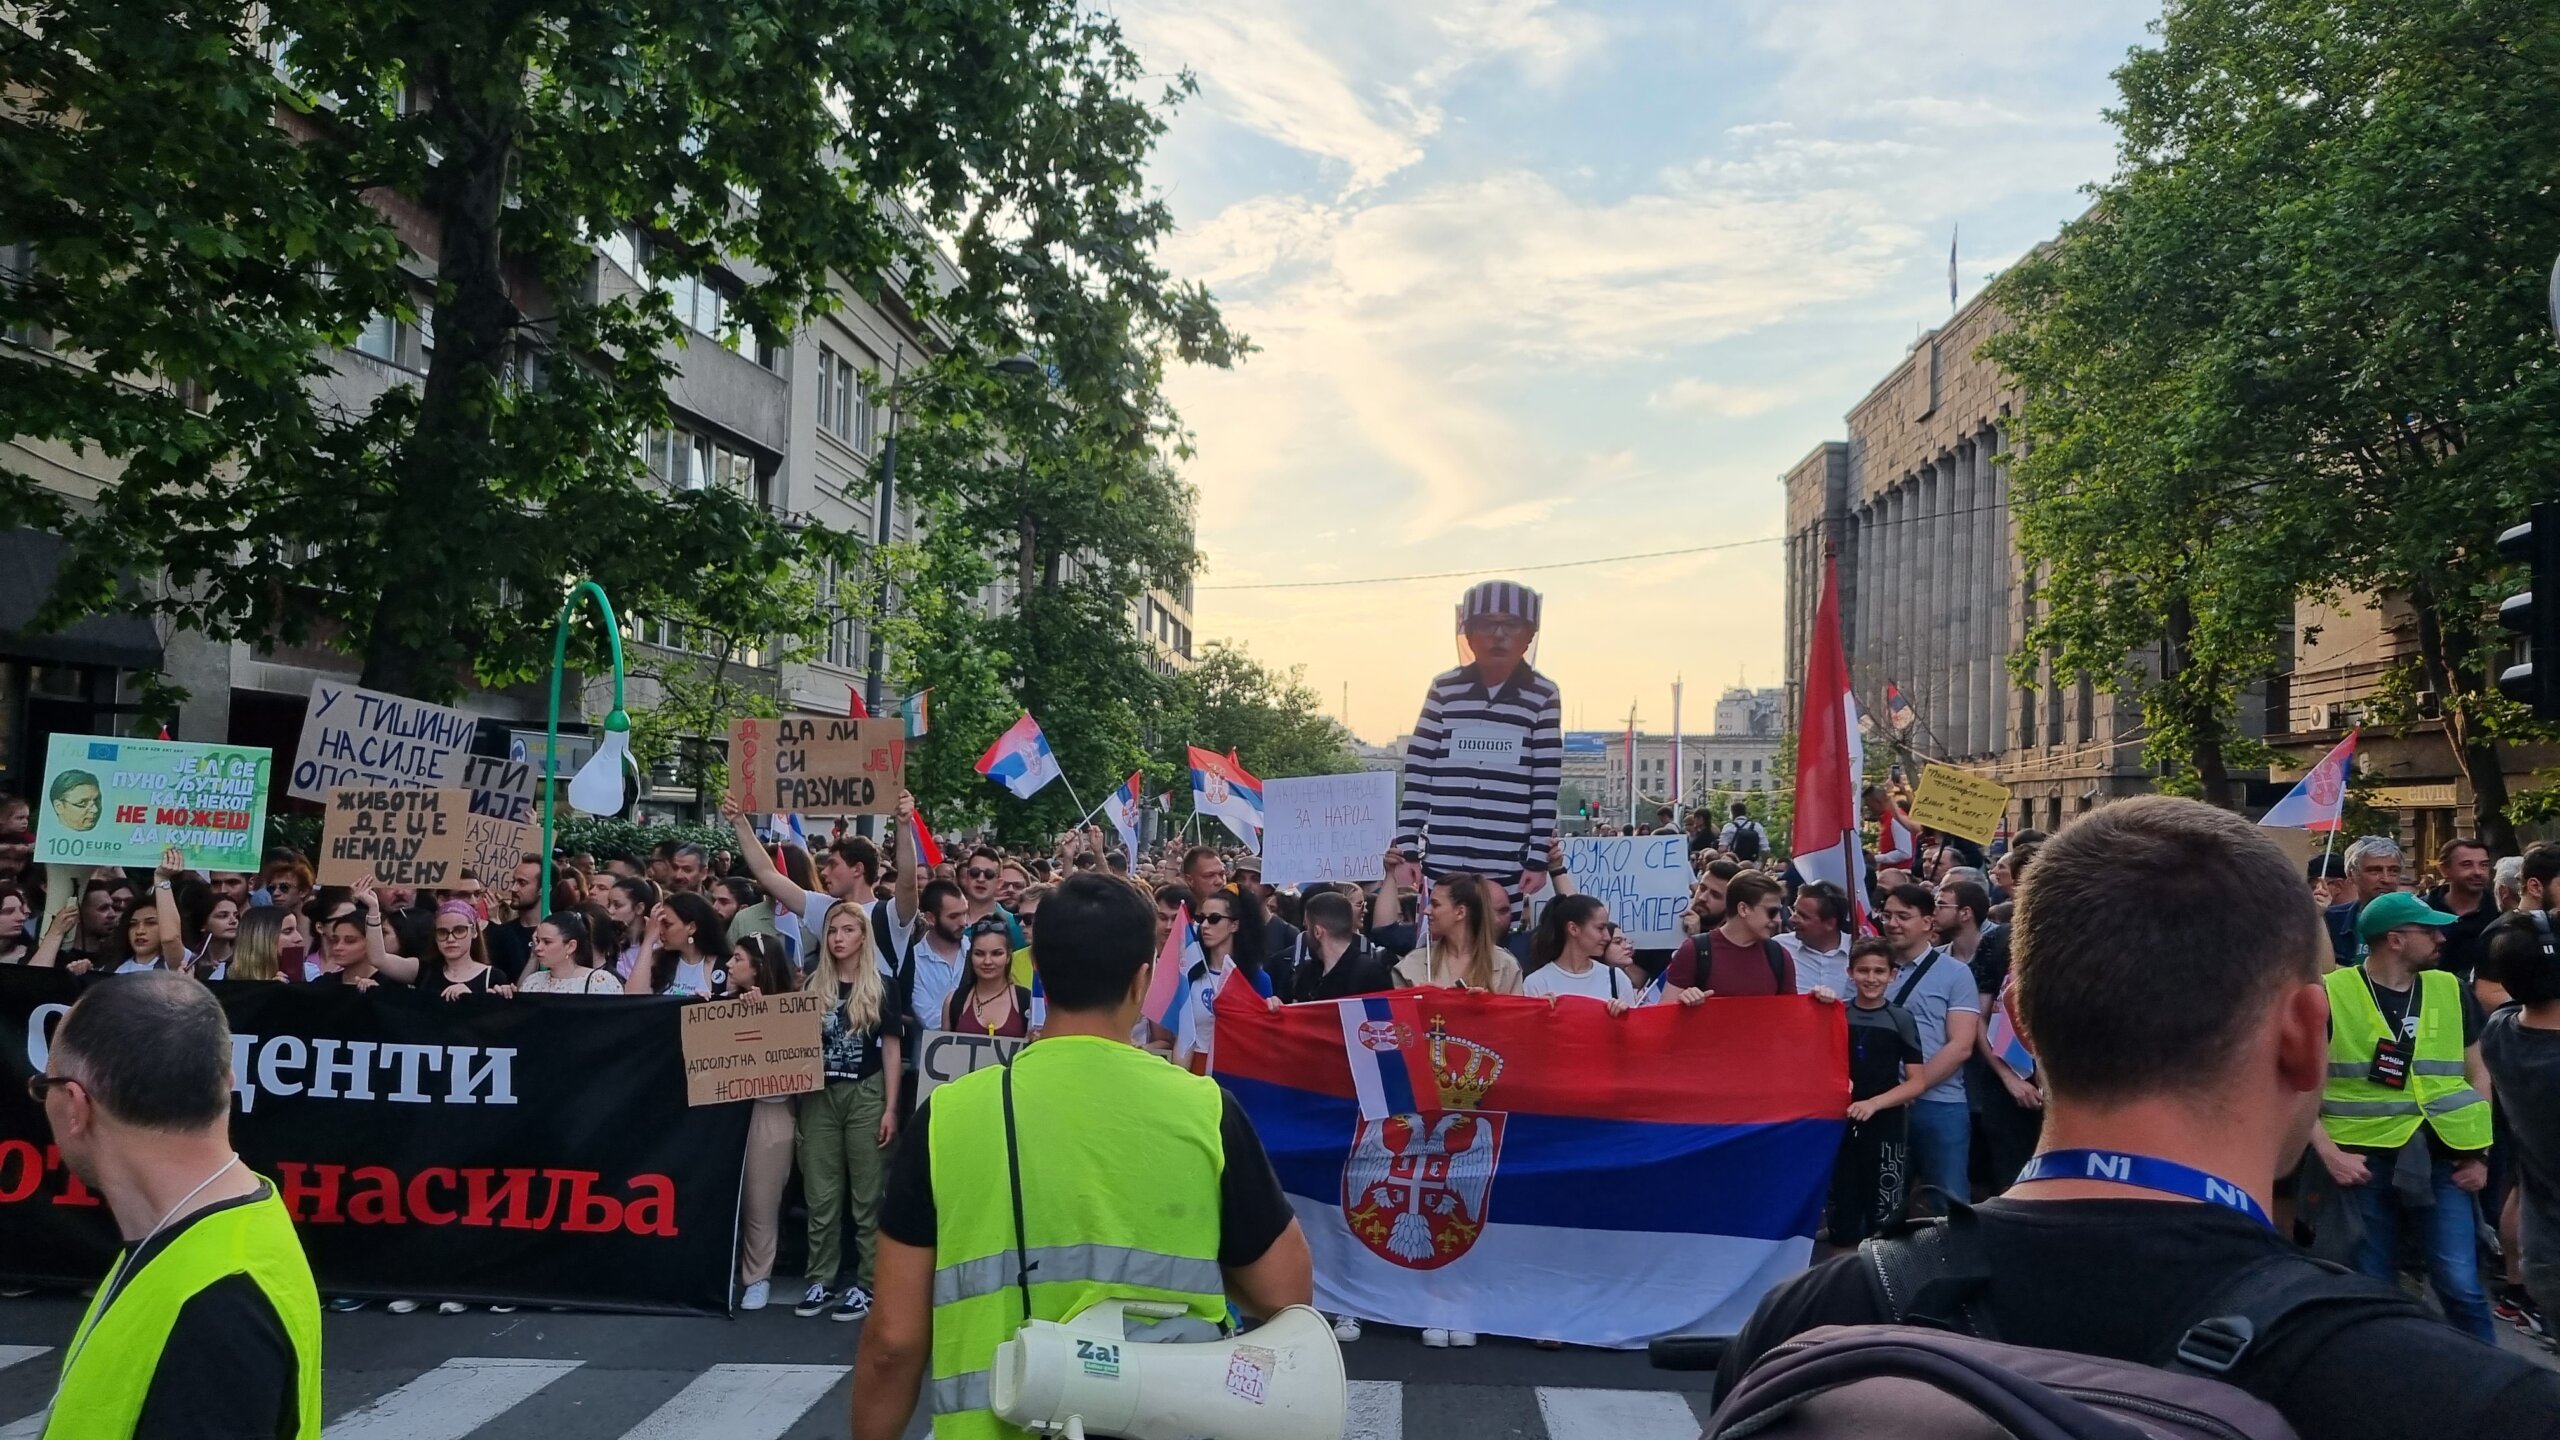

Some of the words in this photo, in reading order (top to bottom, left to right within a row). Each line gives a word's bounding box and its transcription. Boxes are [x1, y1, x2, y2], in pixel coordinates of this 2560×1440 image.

[315, 688, 342, 718] У
[354, 693, 475, 754] ТИШИНИ
[776, 720, 815, 747] ДА
[826, 720, 859, 742] ЛИ
[318, 727, 450, 779] НАСИЉЕ
[776, 749, 806, 773] СИ
[173, 757, 197, 774] ЈЕ
[230, 761, 256, 778] СЕ
[737, 719, 761, 813] ДОСТА
[112, 771, 168, 789] ПУНО
[175, 776, 255, 796] ЉУТИШ
[776, 776, 875, 809] РАЗУМЕО
[150, 792, 190, 811] КАД
[195, 794, 252, 811] НЕКОГ
[336, 791, 439, 812] ЖИВОТИ
[115, 805, 148, 824] НЕ
[155, 808, 250, 830] МОЖЕШ
[349, 811, 447, 838] ДЕЦЕ
[1295, 808, 1311, 829] ЗА
[1325, 805, 1375, 828] НАРОД
[129, 826, 159, 845] ДА
[165, 828, 248, 847] КУПИШ?
[466, 817, 527, 850] ASILJE
[48, 838, 84, 857] 100
[86, 841, 122, 851] EURO
[332, 837, 423, 862] НЕМАЈУ
[1645, 839, 1681, 869] СЕ
[374, 861, 449, 885] ЦЕНУ
[1315, 858, 1333, 879] ЗА
[1580, 874, 1639, 902] КОНАЦ
[779, 996, 819, 1014] ВЛАСТ
[687, 1053, 756, 1075] АПСОЛУТНА
[2086, 1152, 2131, 1181] N1
[2206, 1177, 2249, 1211] N1
[276, 1161, 678, 1237] насиља
[1076, 1339, 1120, 1364] Za!
